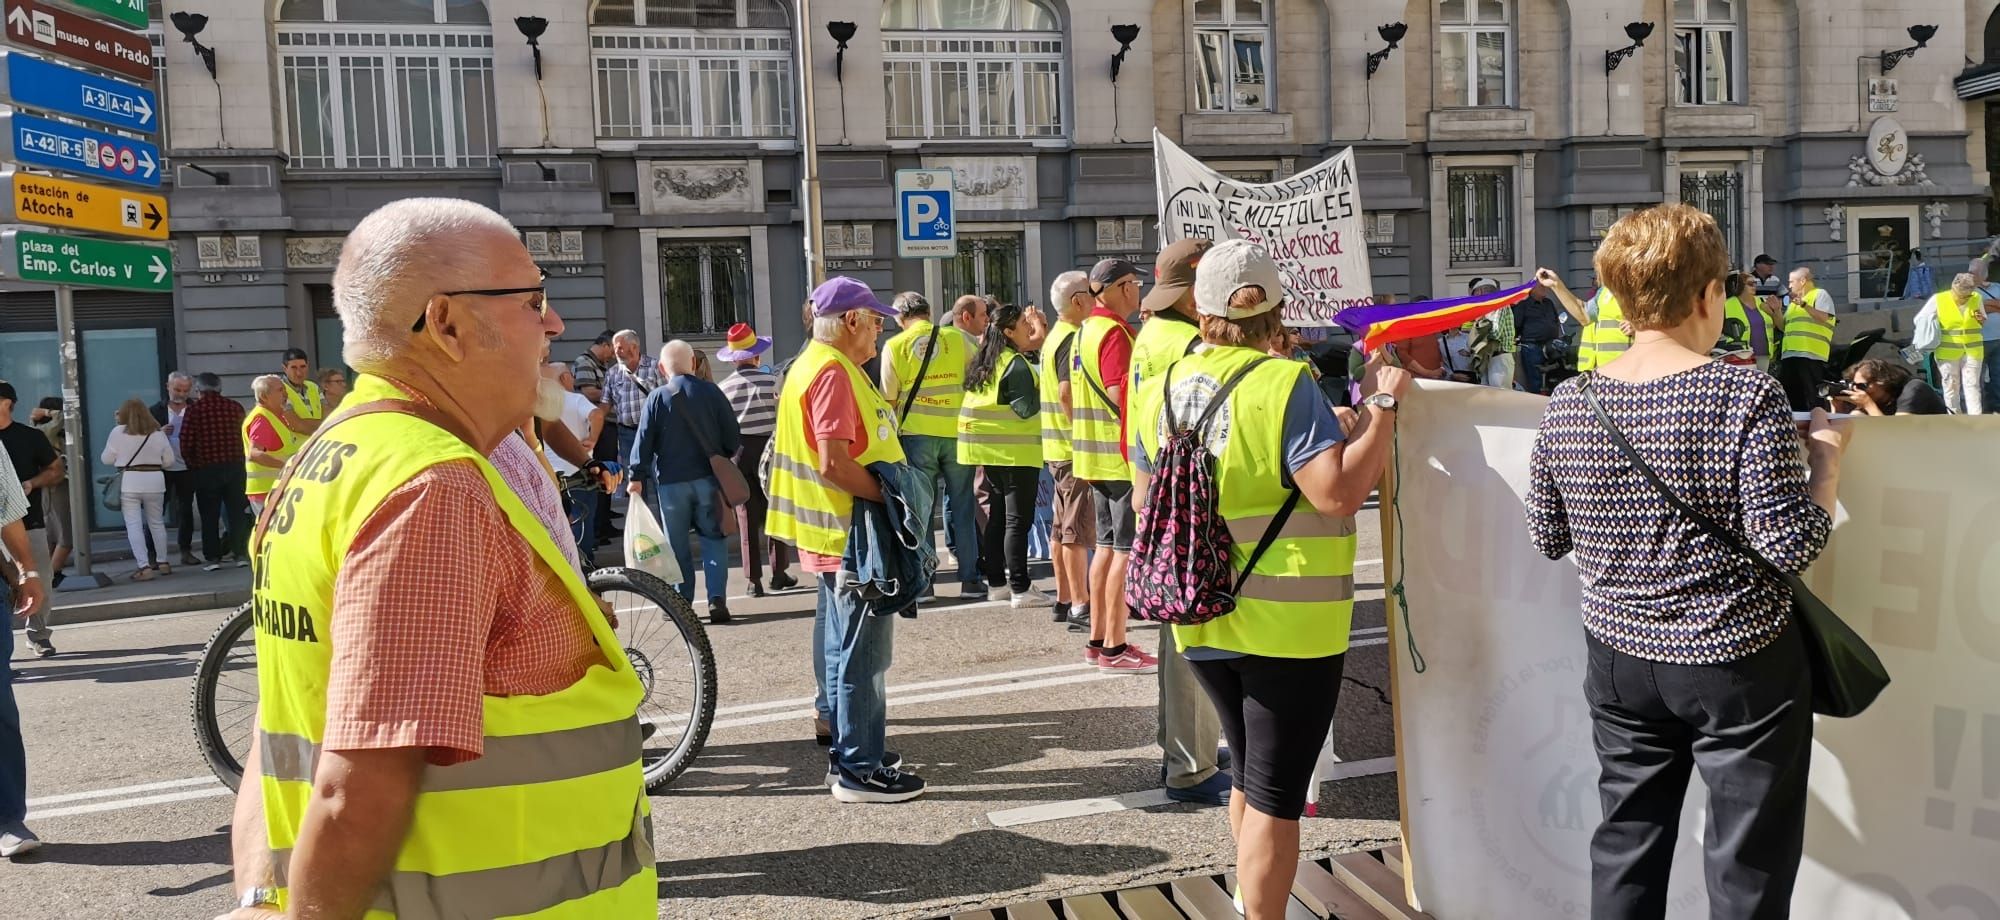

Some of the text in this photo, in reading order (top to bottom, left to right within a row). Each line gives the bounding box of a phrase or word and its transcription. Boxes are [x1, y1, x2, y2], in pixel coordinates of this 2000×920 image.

[56, 29, 150, 66] museo del Prado
[85, 90, 106, 107] A-3
[111, 97, 131, 113] A-4
[25, 133, 56, 152] A-42
[61, 141, 83, 157] R-5
[20, 183, 89, 203] estación de
[21, 197, 74, 219] Atocha
[907, 195, 940, 237] P
[1197, 202, 1214, 221] UN
[1244, 191, 1354, 229] MOSTOLES
[1183, 222, 1215, 242] PASO
[22, 240, 79, 257] plaza del
[1279, 226, 1343, 260] defensa
[22, 255, 133, 279] Emp. Carlos V
